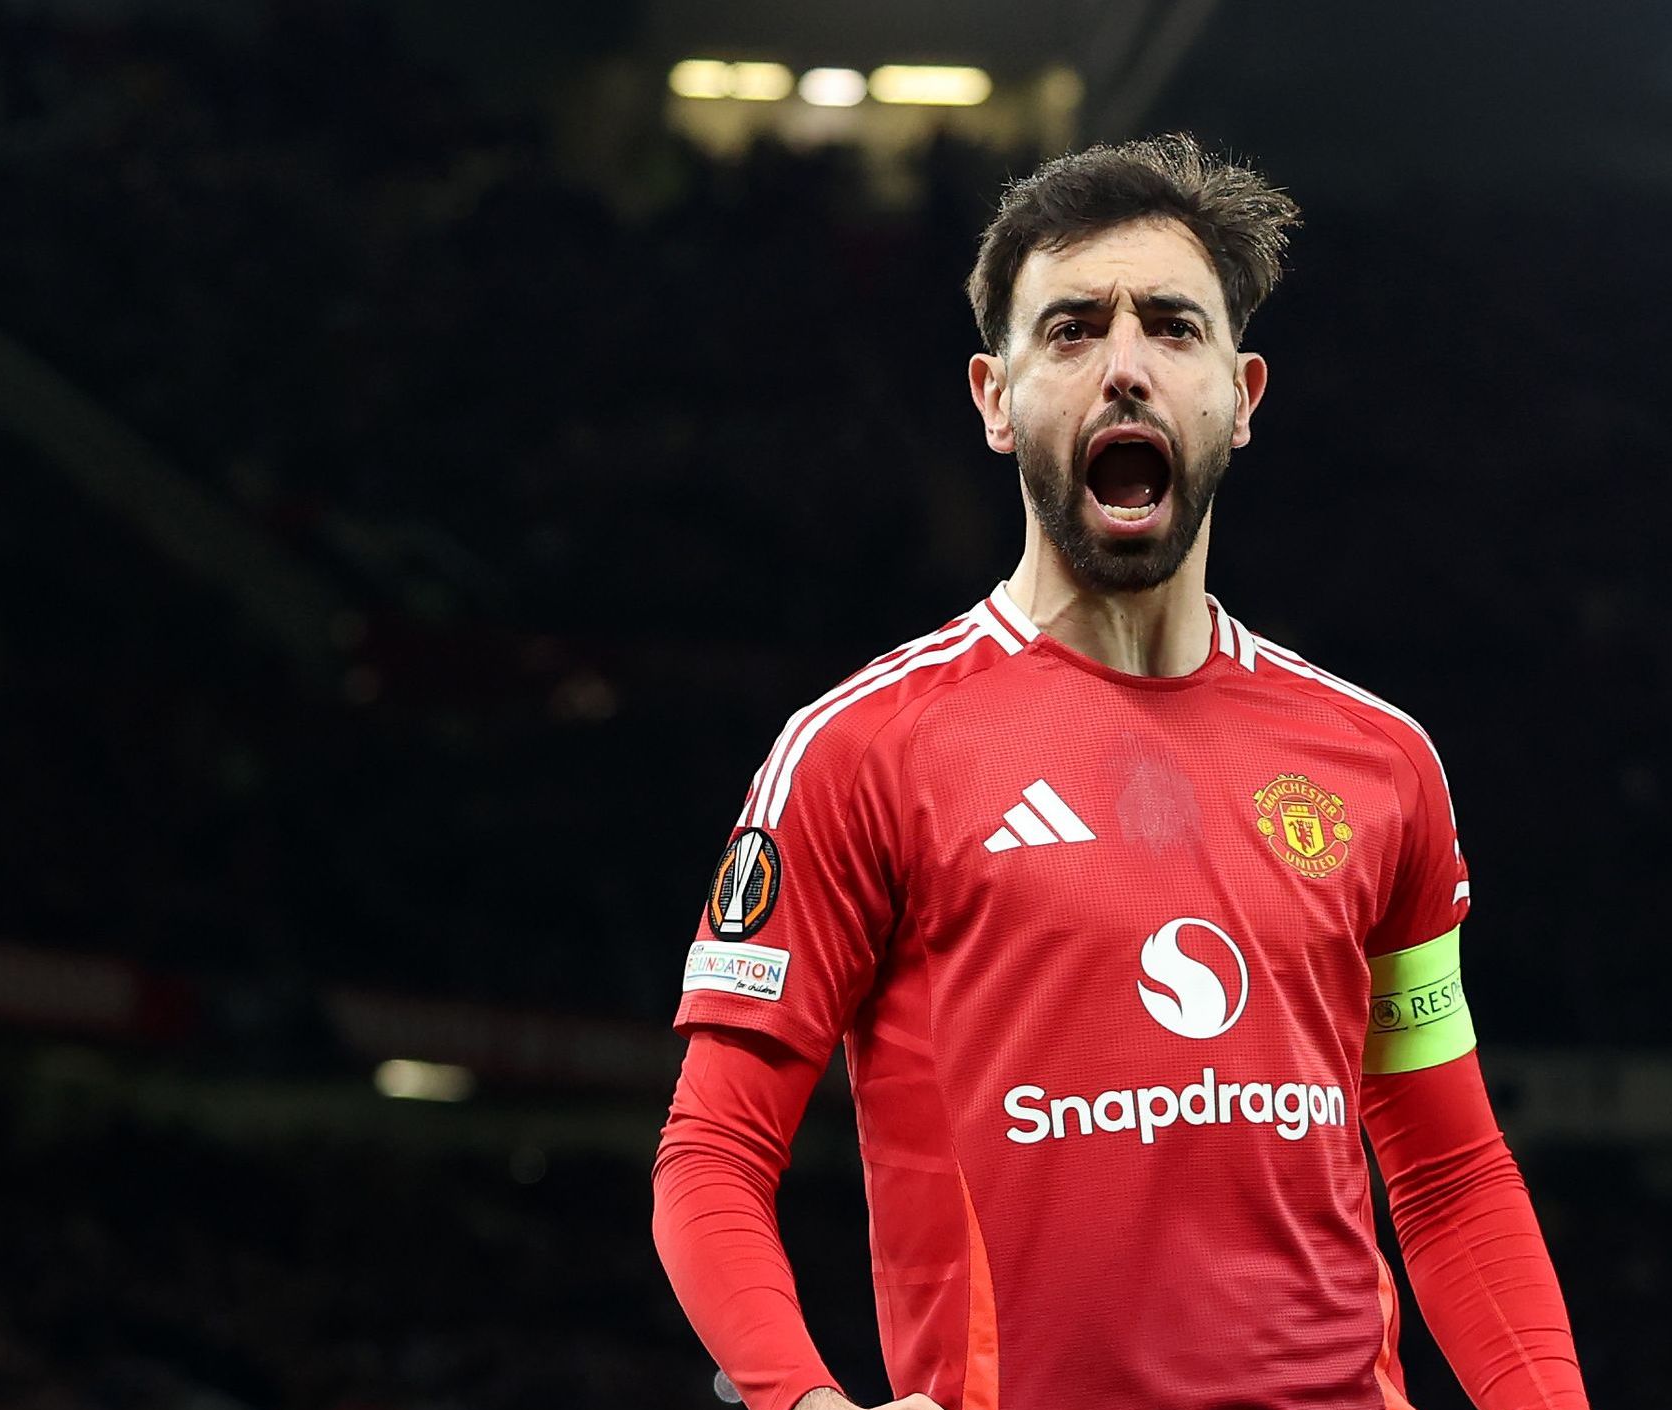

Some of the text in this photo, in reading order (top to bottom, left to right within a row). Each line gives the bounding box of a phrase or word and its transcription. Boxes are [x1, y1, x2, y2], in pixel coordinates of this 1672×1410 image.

[1262, 782, 1338, 817] MANCHESTER
[1285, 850, 1337, 871] UNITED
[1003, 1067, 1346, 1145] Snapdragon
